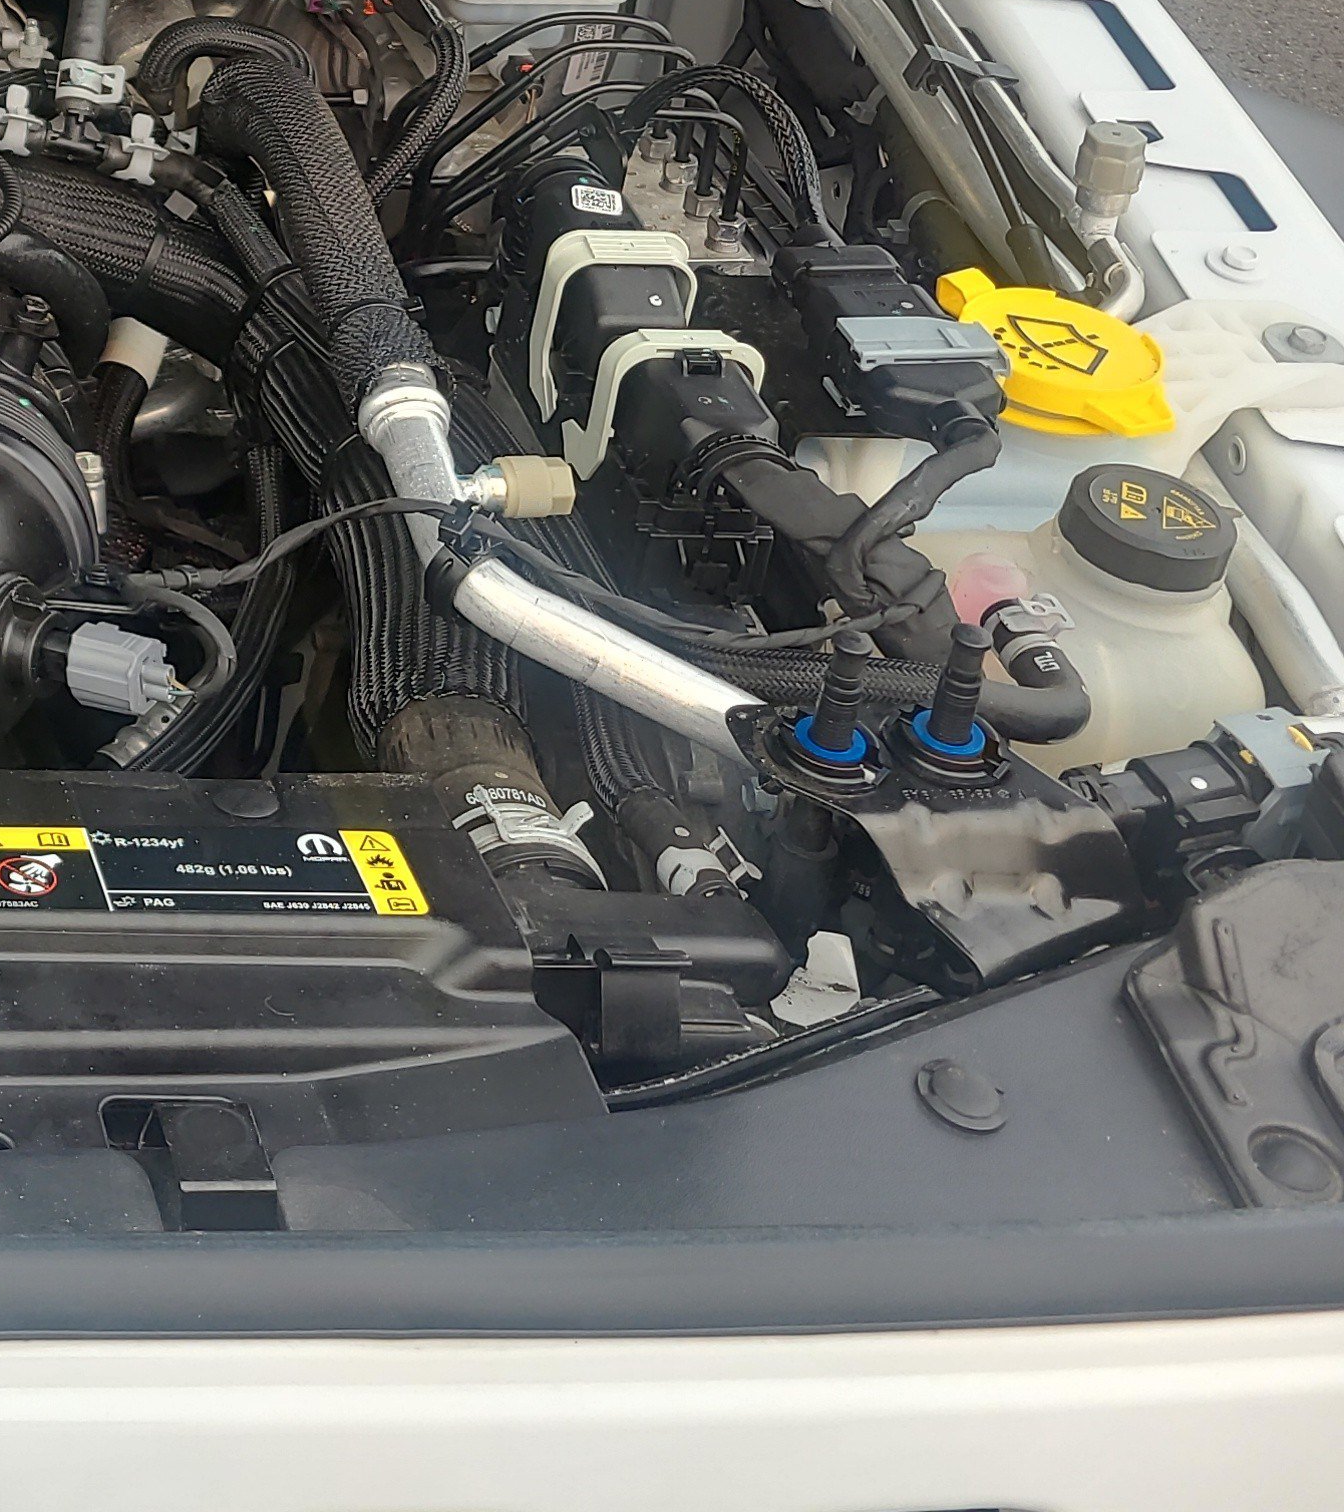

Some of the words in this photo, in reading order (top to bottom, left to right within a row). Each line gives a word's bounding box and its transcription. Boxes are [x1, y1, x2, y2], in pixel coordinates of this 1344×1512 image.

[113, 837, 184, 849] R-1234yf
[176, 864, 216, 876] 482g
[218, 864, 258, 876] (1.06
[261, 865, 293, 878] lbs)
[143, 897, 176, 908] PAG
